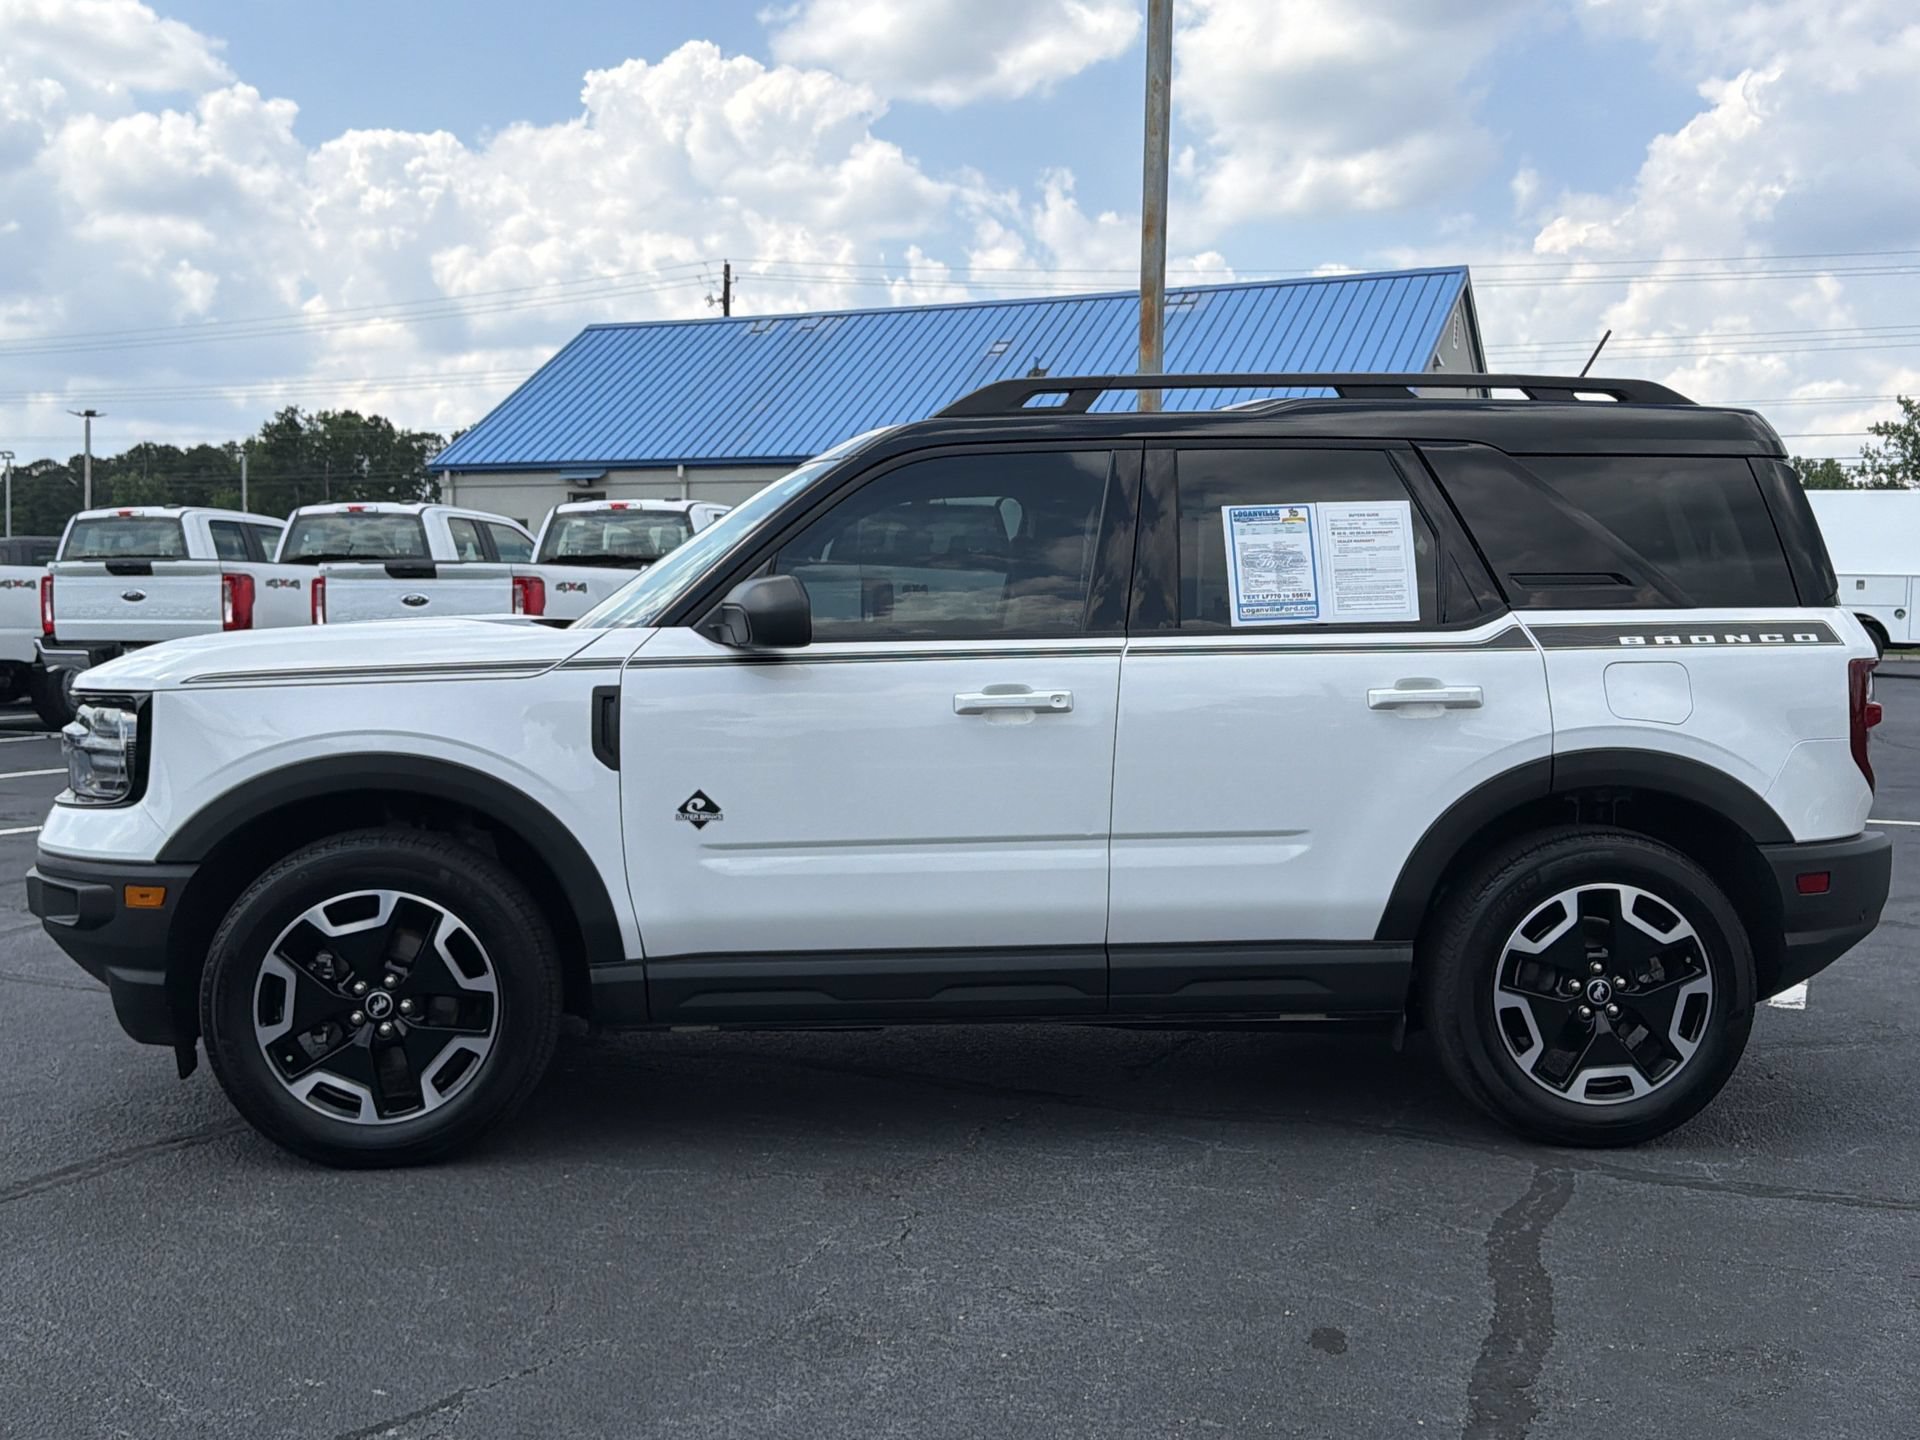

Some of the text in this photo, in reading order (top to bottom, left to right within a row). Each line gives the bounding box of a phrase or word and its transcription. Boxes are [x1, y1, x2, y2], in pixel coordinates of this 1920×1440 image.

[1233, 509, 1280, 518] LOGANVILLE
[147, 606, 211, 617] DUTY
[1241, 605, 1316, 614] LoganvilleFord.com
[1618, 633, 1820, 645] BRONCO
